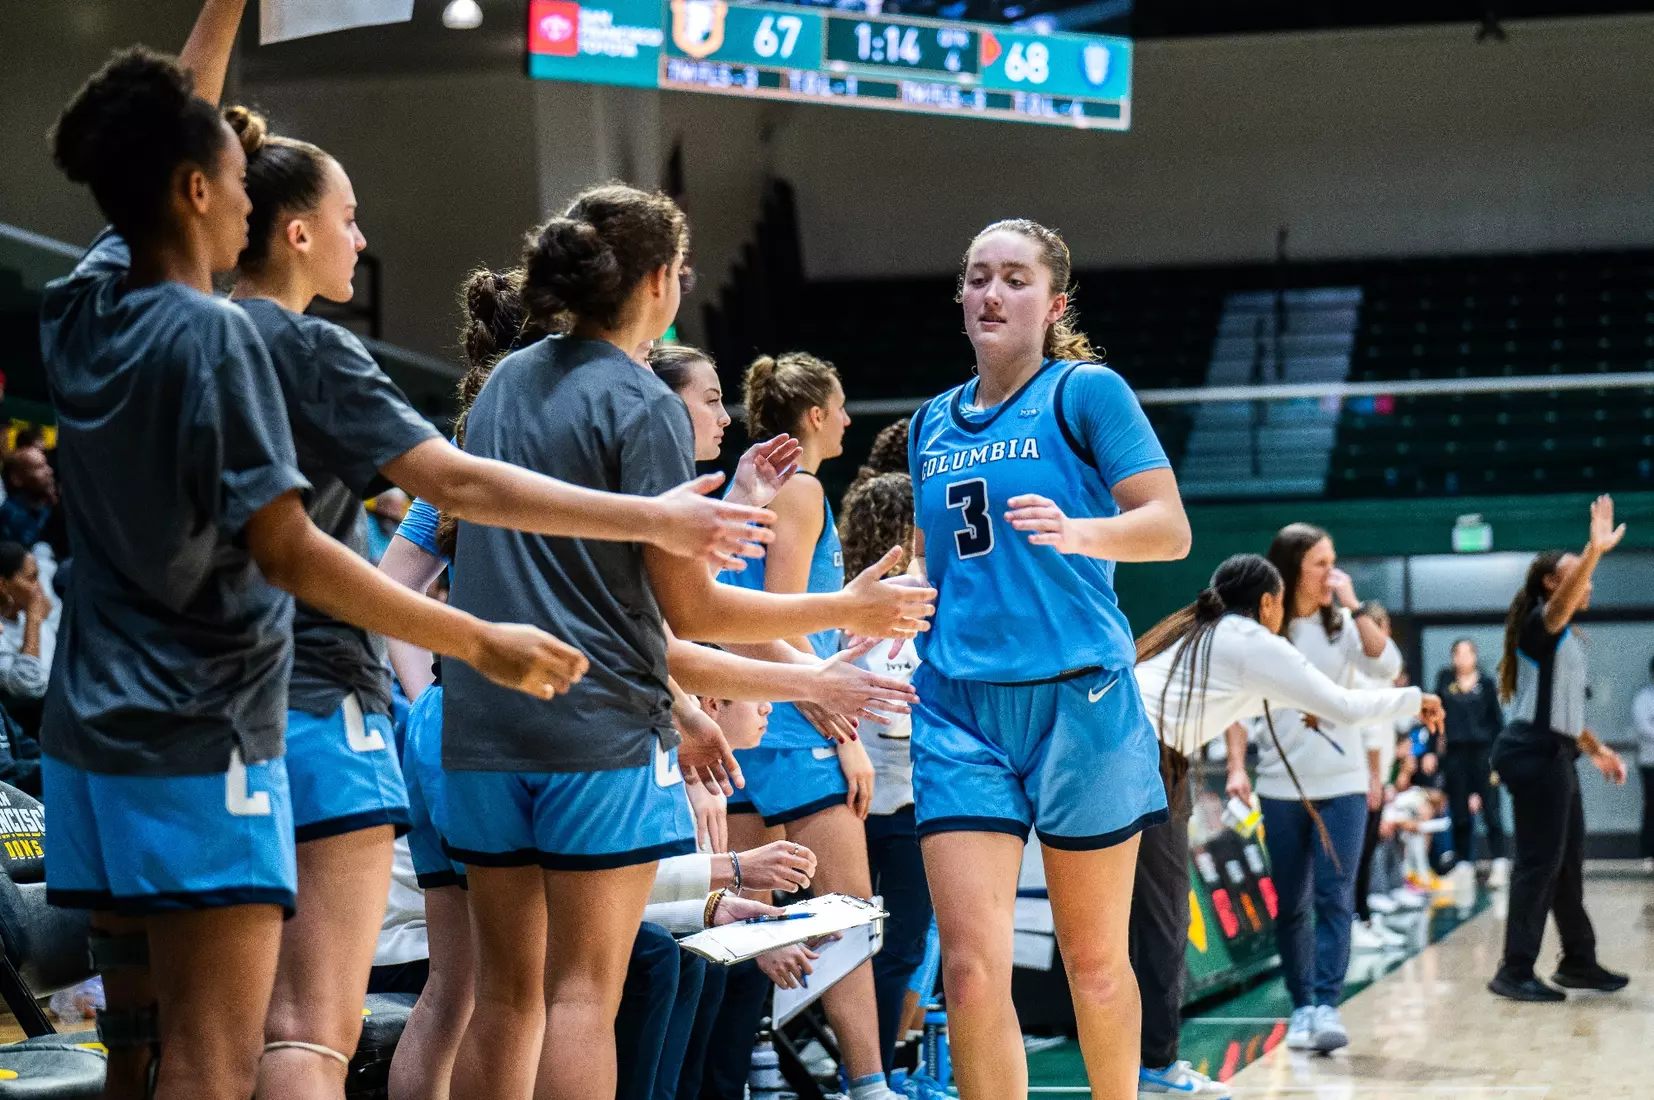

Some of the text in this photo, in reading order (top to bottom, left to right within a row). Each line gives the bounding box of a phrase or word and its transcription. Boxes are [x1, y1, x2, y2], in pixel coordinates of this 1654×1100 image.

[753, 14, 803, 58] 67
[853, 21, 921, 65] 1:14
[1003, 41, 1049, 84] 68
[921, 437, 1040, 482] COLUMBIA
[946, 477, 995, 560] 3
[4, 840, 45, 860] DONS
